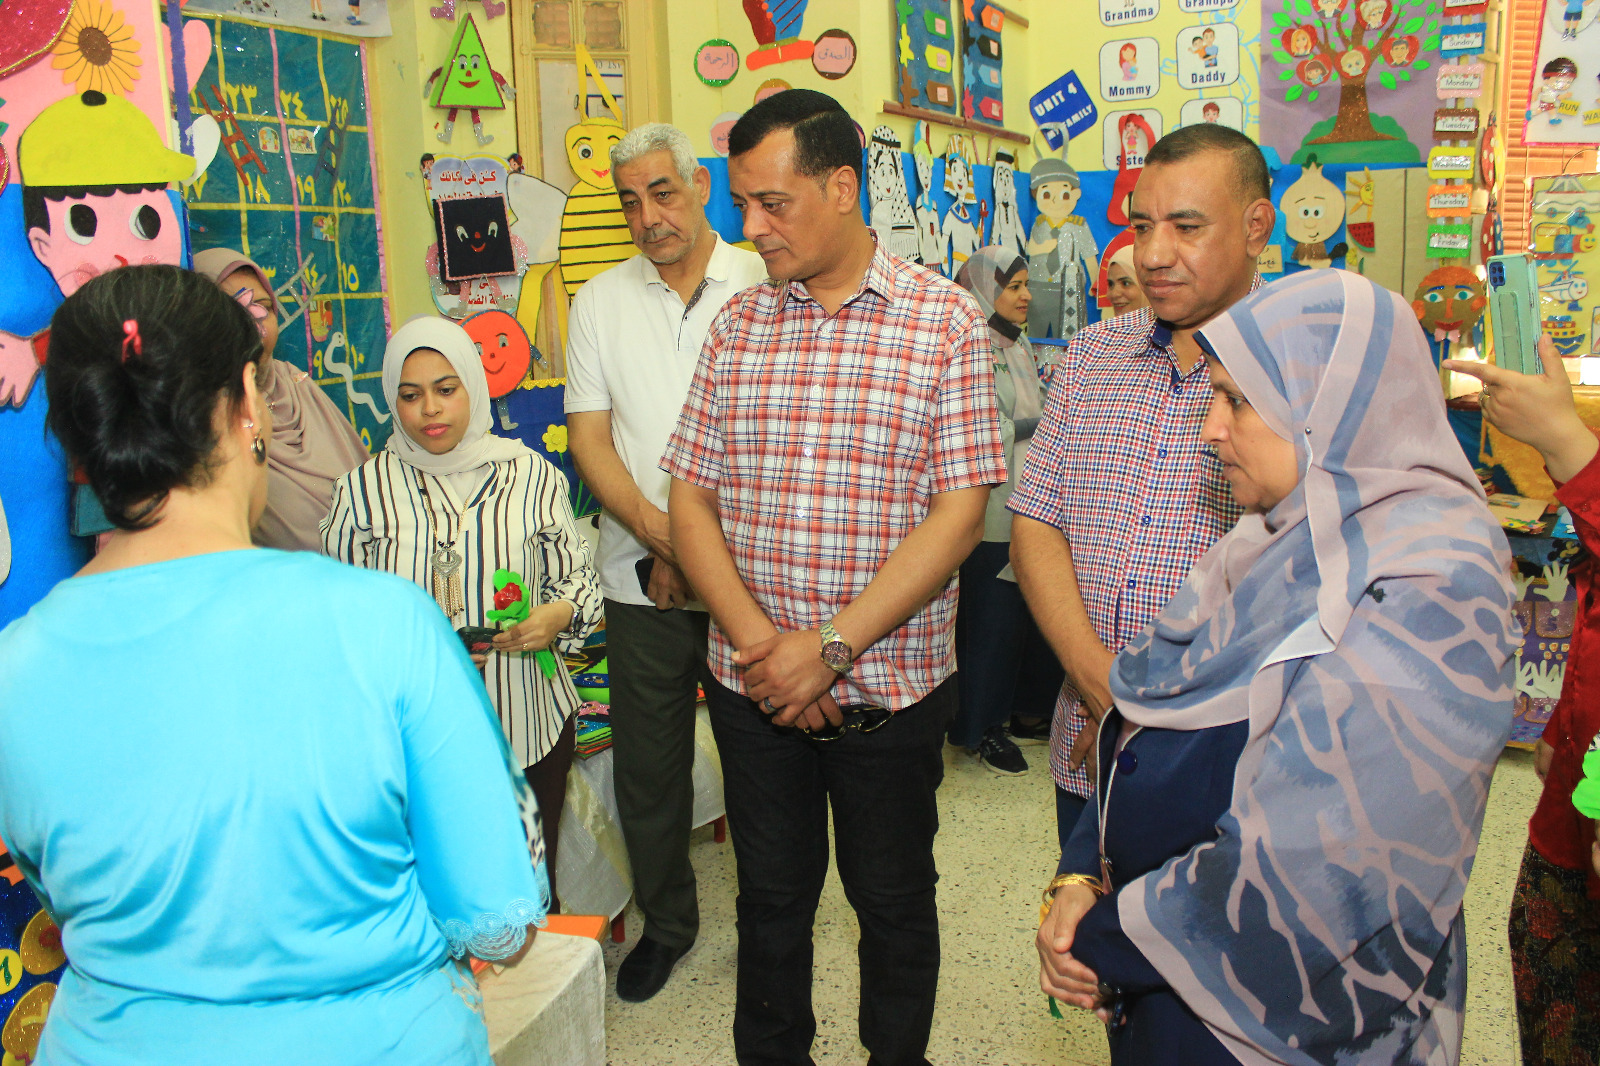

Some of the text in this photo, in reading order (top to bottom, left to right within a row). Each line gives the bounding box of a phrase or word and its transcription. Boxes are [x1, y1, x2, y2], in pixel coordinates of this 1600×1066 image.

[1105, 7, 1154, 22] Grandma
[1449, 39, 1475, 47] Sunday
[1191, 71, 1226, 84] Daddy
[1445, 79, 1474, 87] Monday
[1109, 85, 1151, 97] Mommy
[1034, 82, 1078, 117] UNIT 4
[1559, 102, 1579, 112] RUN
[1442, 121, 1470, 129] Tuesday
[1437, 238, 1460, 246] Friday
